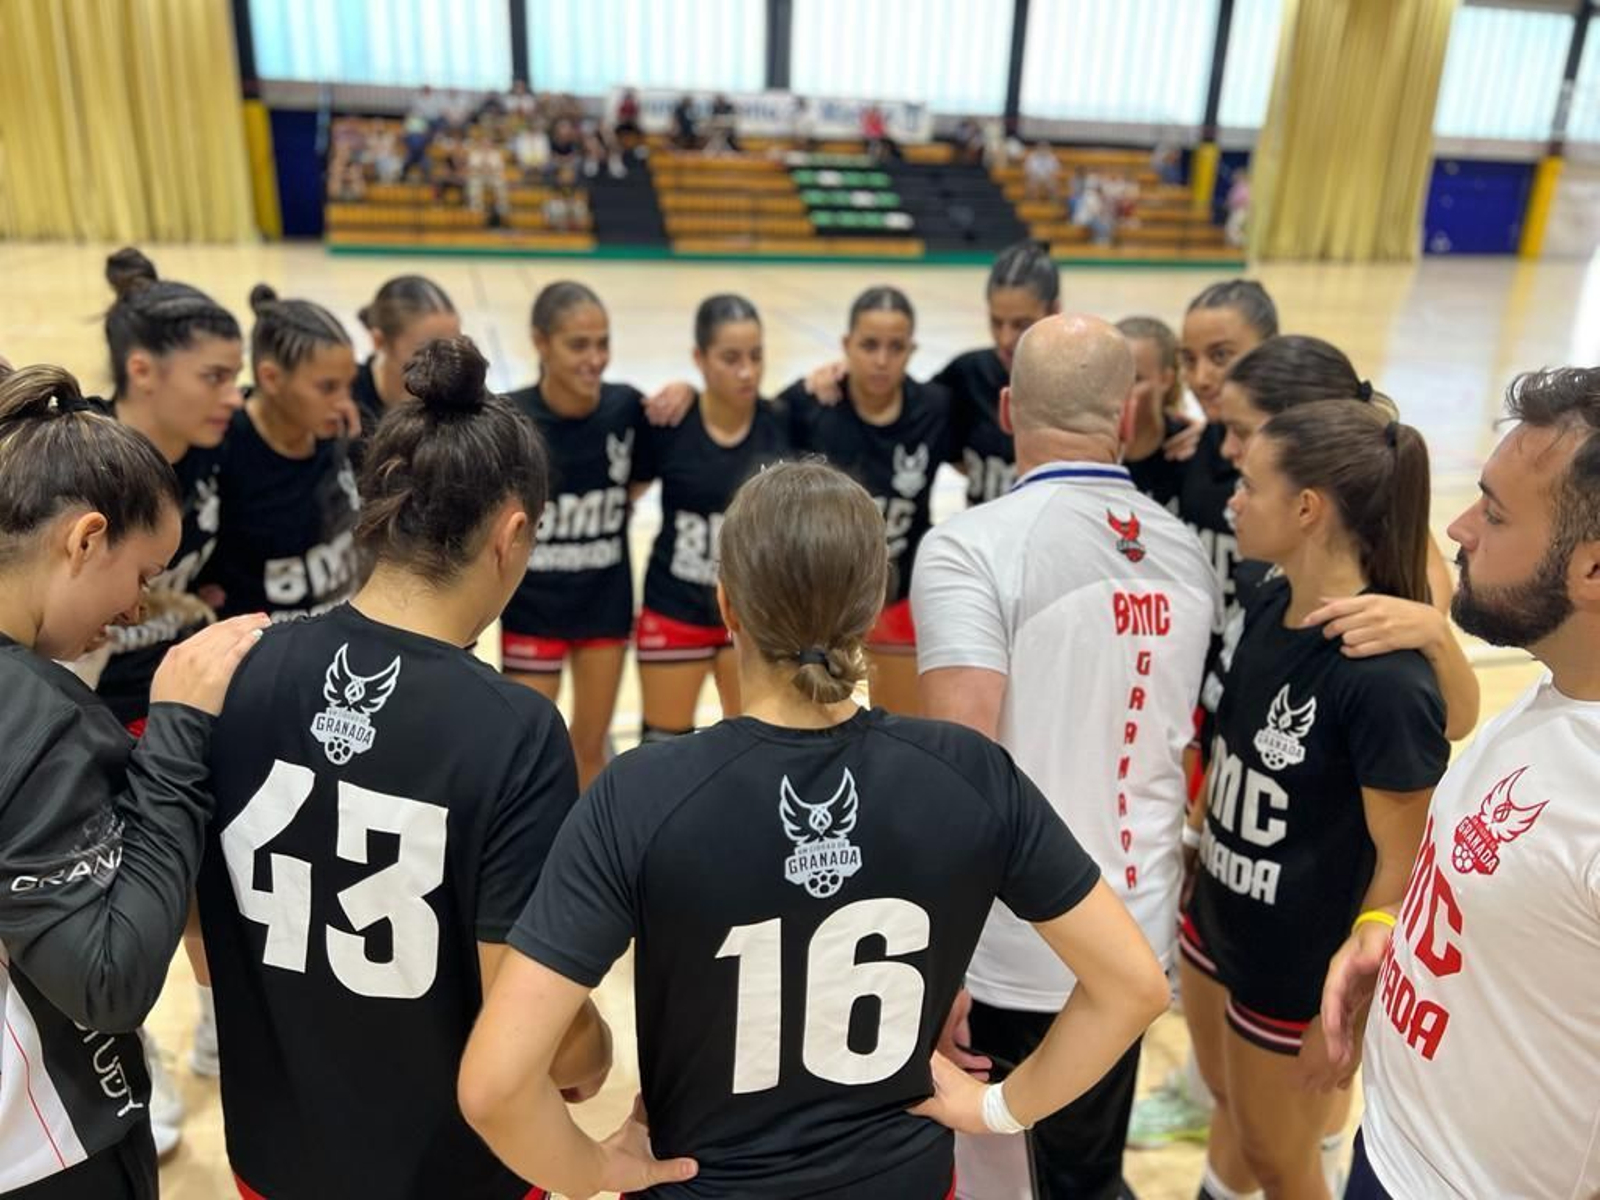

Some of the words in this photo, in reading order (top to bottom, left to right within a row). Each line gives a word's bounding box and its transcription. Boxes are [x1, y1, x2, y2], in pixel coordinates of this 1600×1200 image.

[1113, 592, 1170, 636] BMC
[316, 716, 373, 745] GRANADA
[1117, 651, 1151, 890] GRANADA
[788, 849, 858, 874] GRANADA
[1458, 819, 1499, 873] GRANADA
[220, 759, 449, 999] 43
[715, 898, 931, 1094] 16
